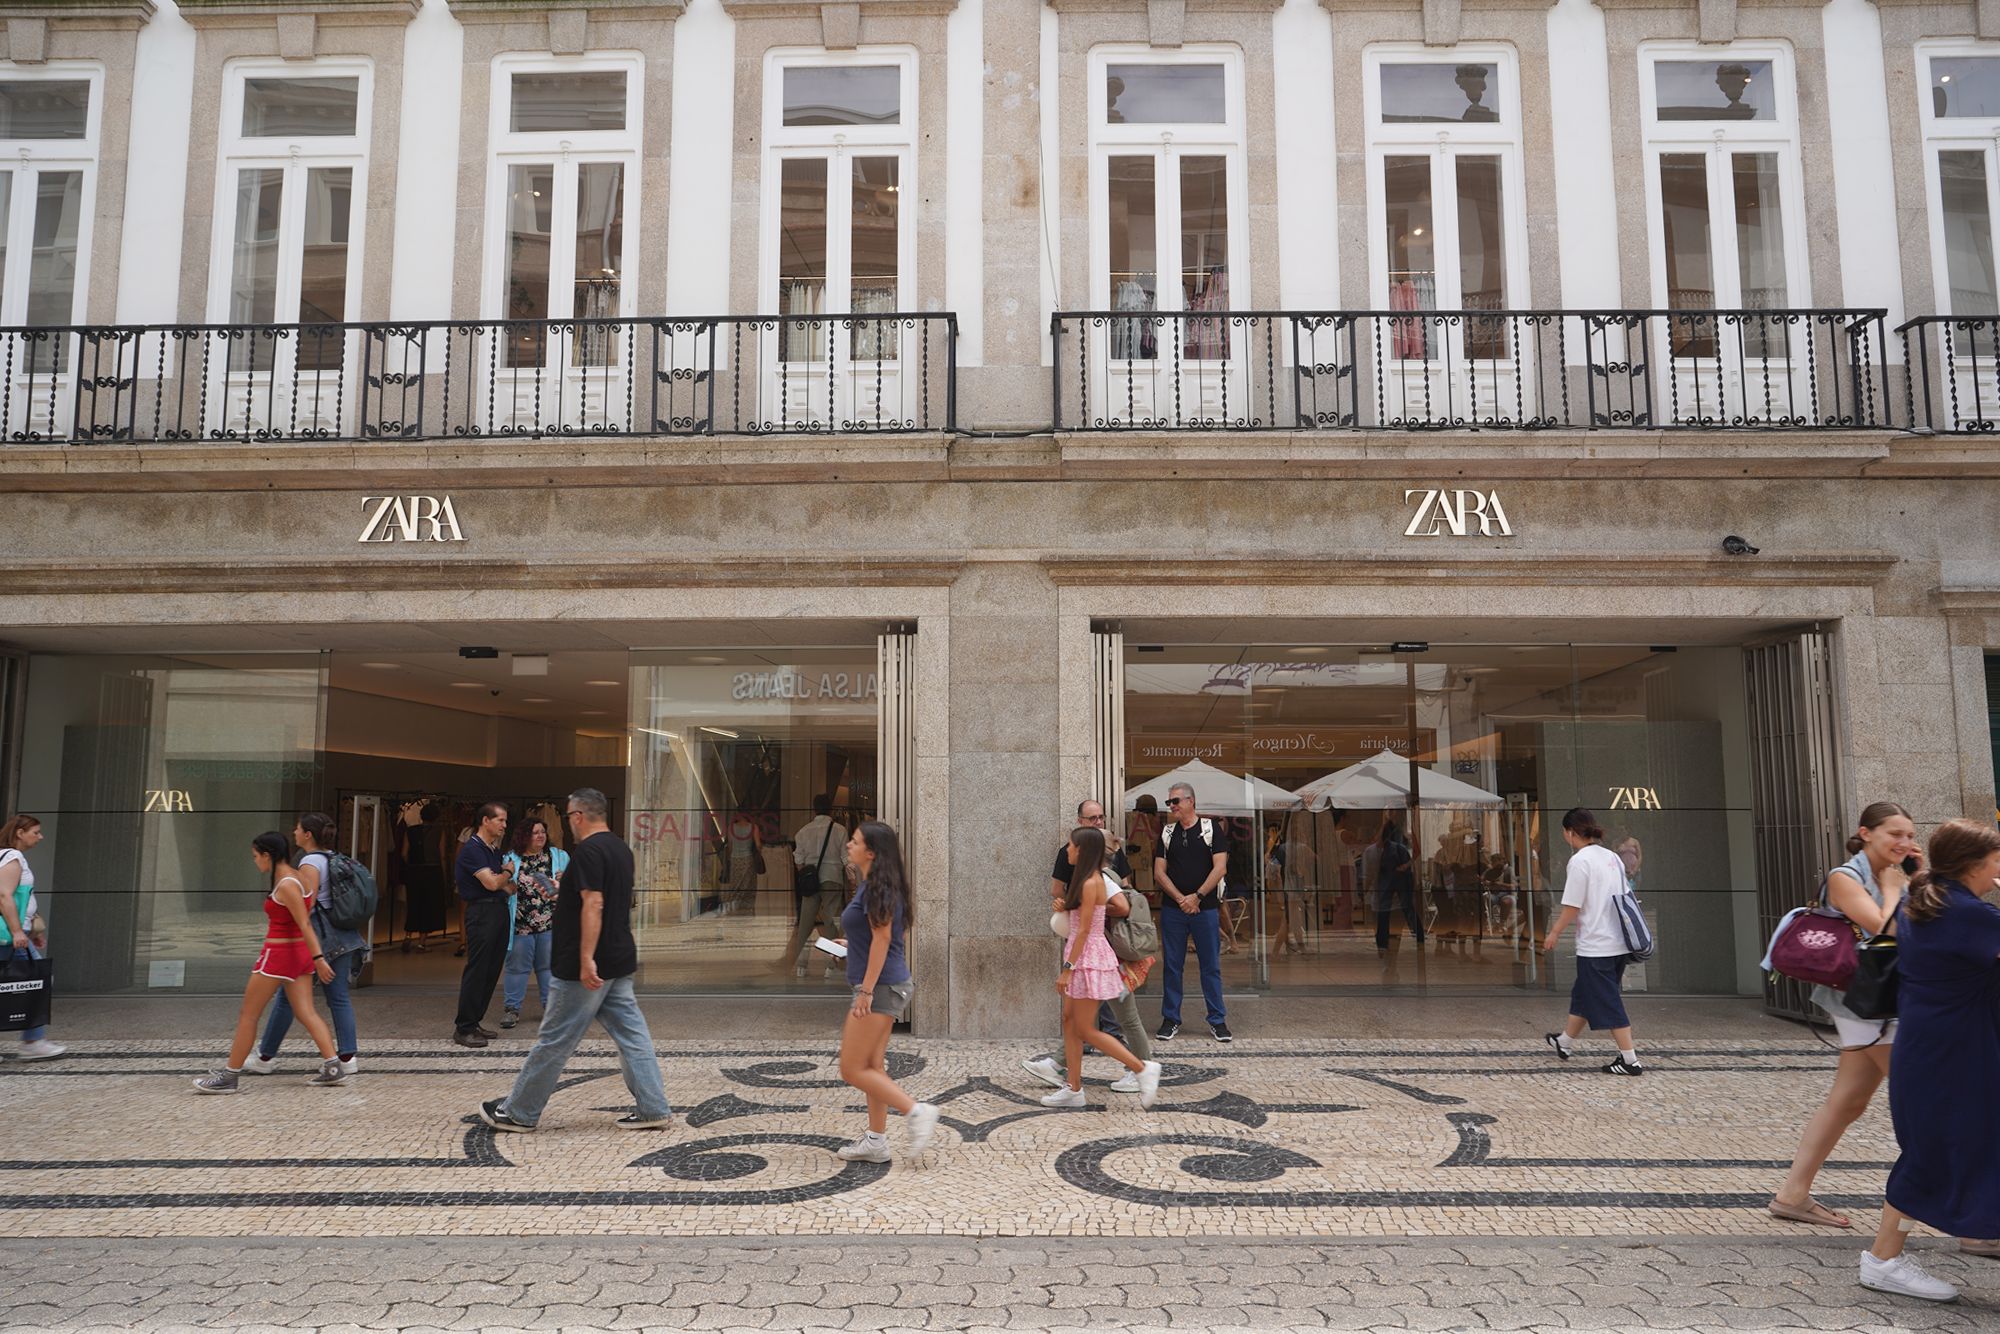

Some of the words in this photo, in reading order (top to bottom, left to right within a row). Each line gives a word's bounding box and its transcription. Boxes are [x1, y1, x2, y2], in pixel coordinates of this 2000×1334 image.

[358, 494, 470, 543] ZARA
[1404, 488, 1518, 537] ZARA
[144, 789, 194, 813] ZARA
[1608, 787, 1662, 811] ZARA
[633, 812, 781, 842] SALDOS
[16, 982, 41, 990] Locker
